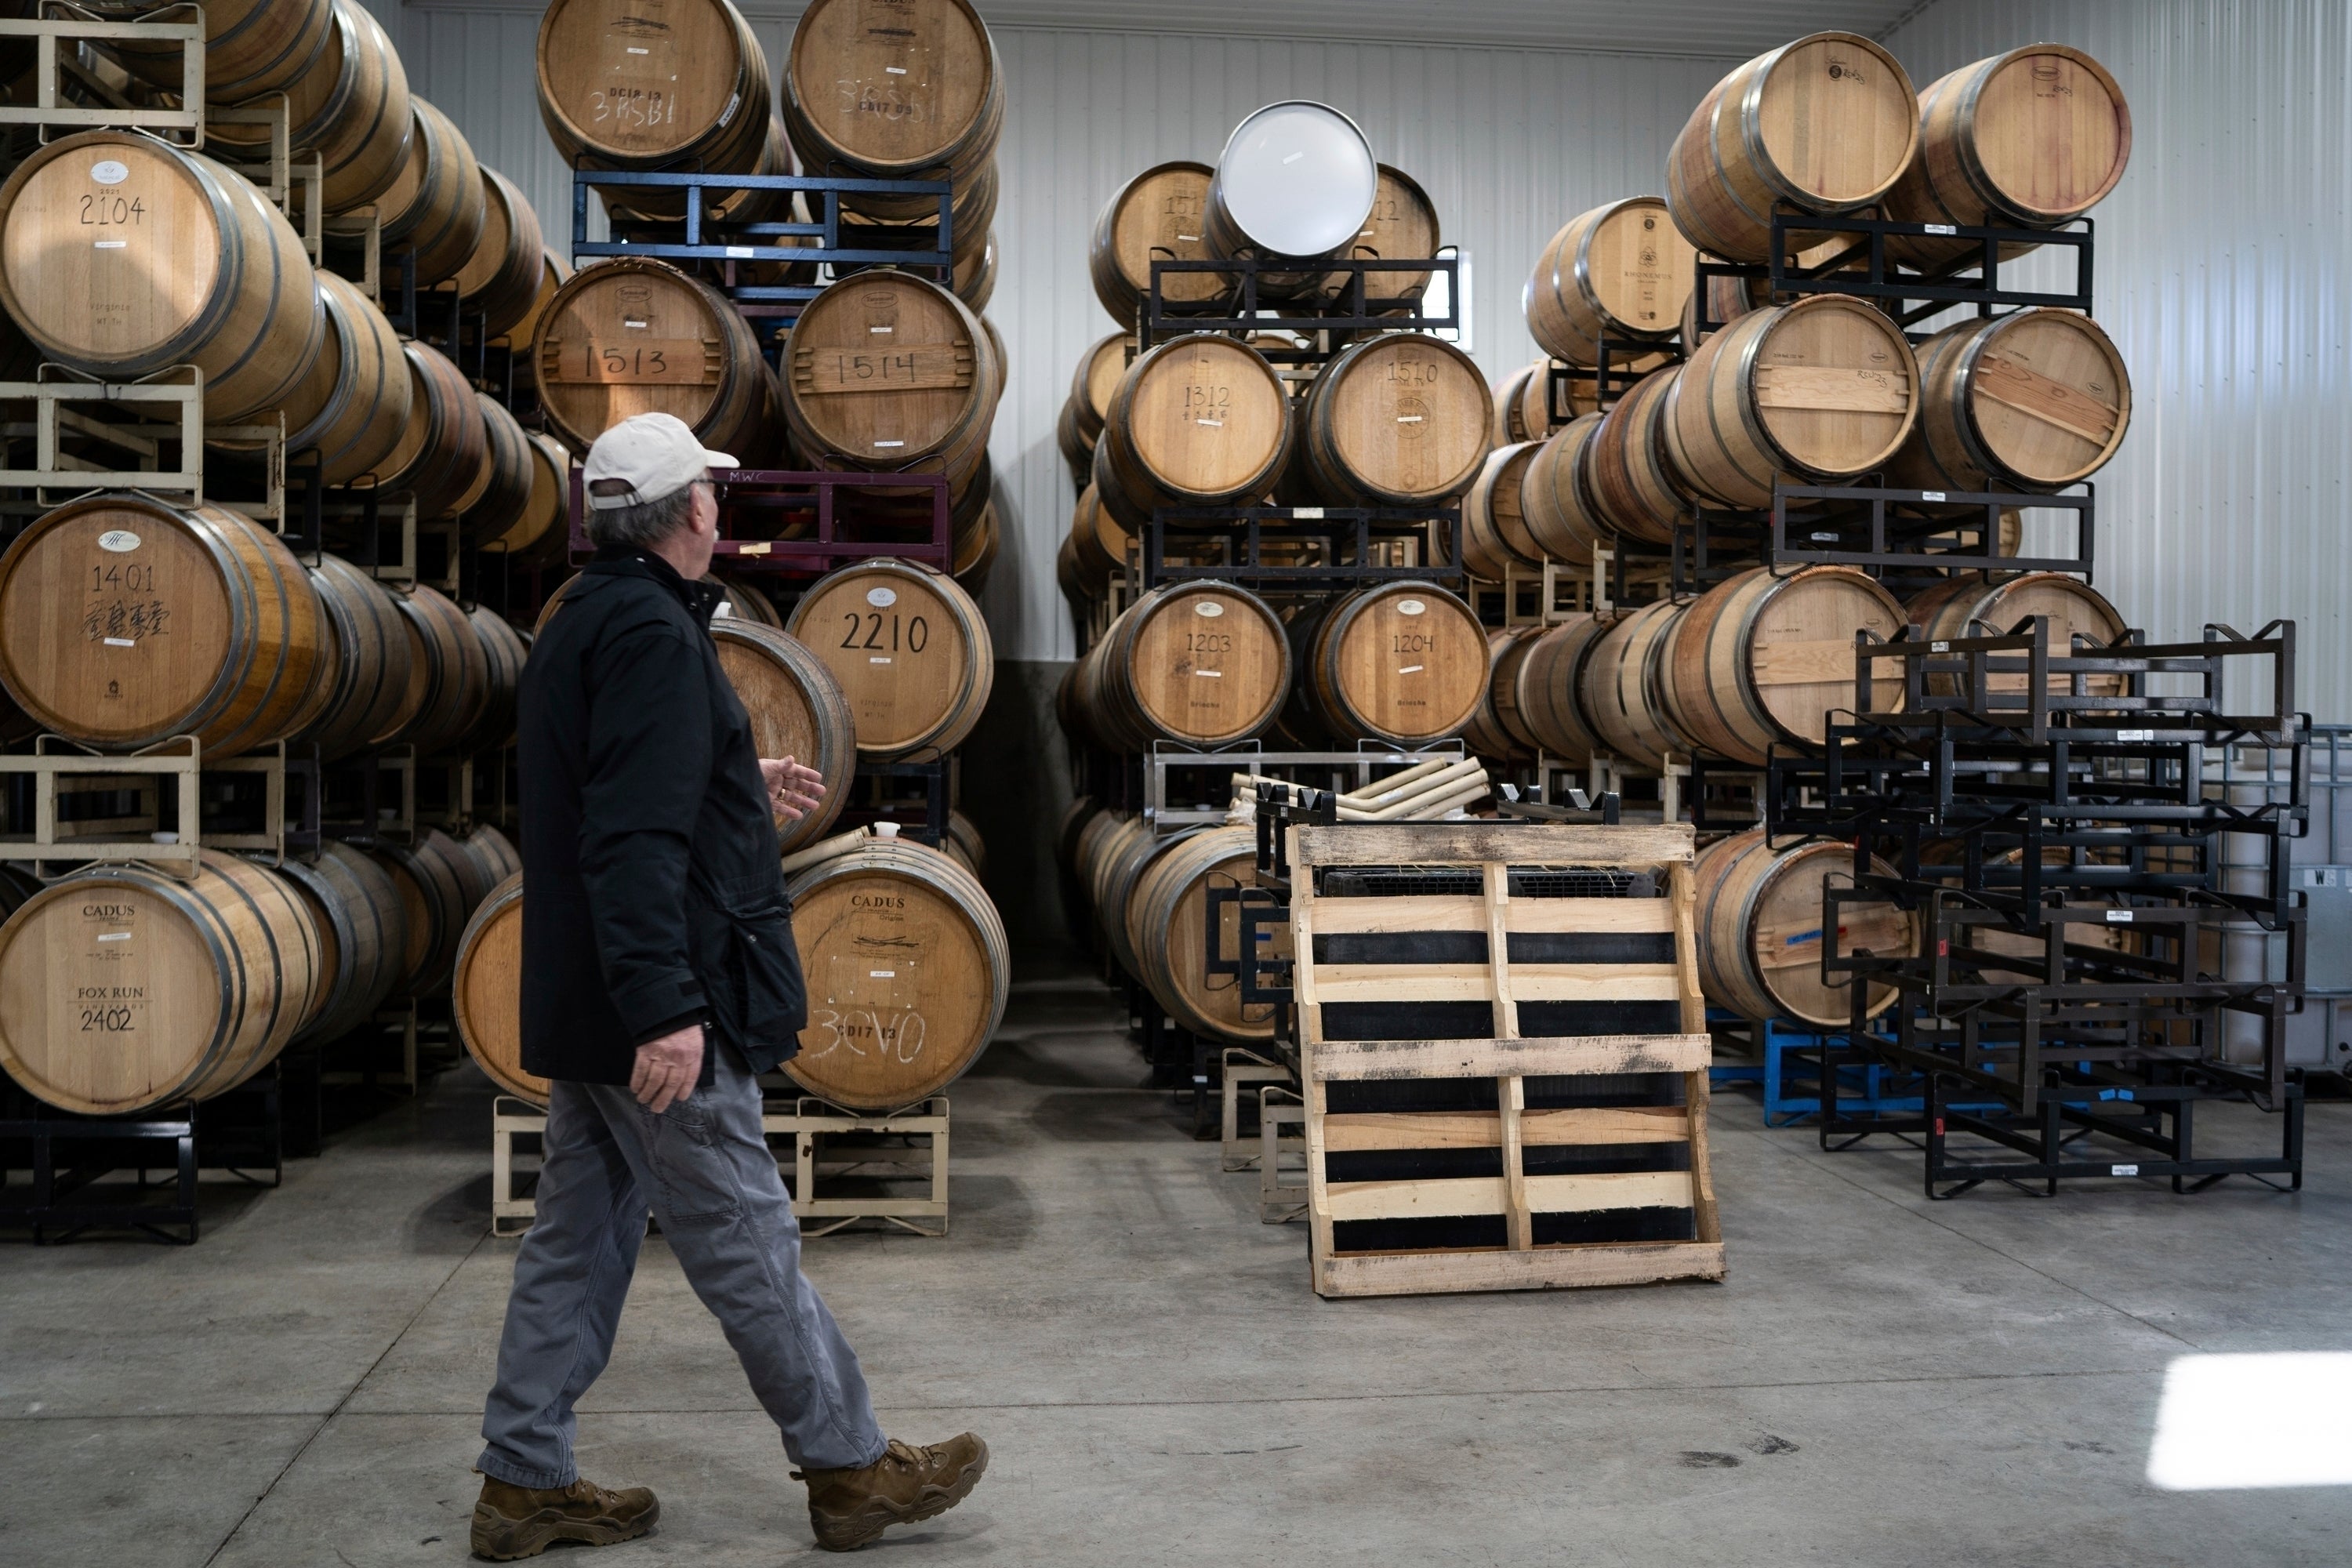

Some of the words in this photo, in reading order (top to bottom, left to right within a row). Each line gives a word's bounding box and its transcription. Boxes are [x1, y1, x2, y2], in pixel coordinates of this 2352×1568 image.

[80, 194, 147, 225] 2104
[1164, 195, 1207, 215] 151
[586, 345, 666, 376] 1513
[839, 353, 916, 383] 1514
[1387, 361, 1438, 383] 1510
[1185, 386, 1230, 407] 1312
[93, 564, 154, 593] 1401
[840, 612, 928, 654] 2210
[1186, 633, 1232, 653] 1203
[1393, 634, 1434, 652] 1204
[82, 904, 135, 917] CADUS
[851, 895, 906, 909] CADUS
[78, 987, 107, 999] FOX
[112, 987, 143, 999] RUN
[81, 1008, 135, 1033] 2402
